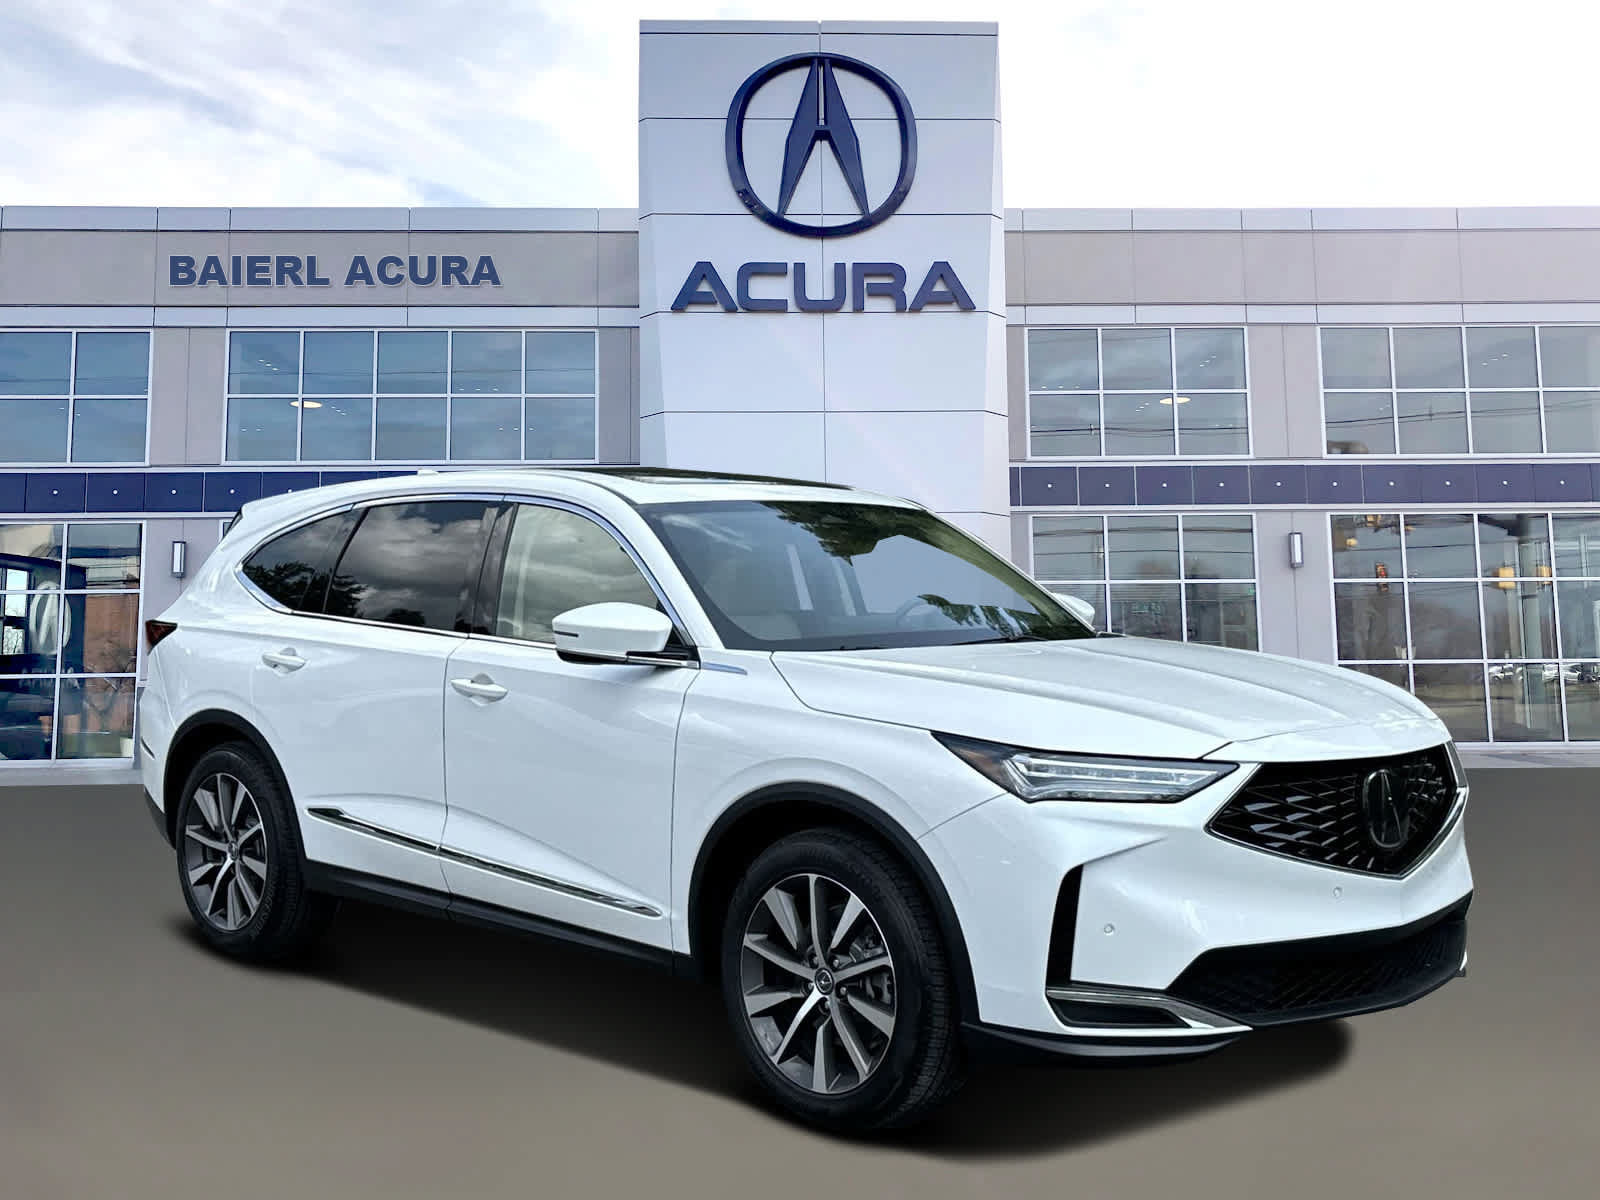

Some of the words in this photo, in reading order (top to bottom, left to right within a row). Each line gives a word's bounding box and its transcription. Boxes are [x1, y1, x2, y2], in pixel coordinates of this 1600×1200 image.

[170, 256, 330, 287] BAIERL
[345, 256, 501, 287] ACURA
[671, 261, 977, 312] ACURA
